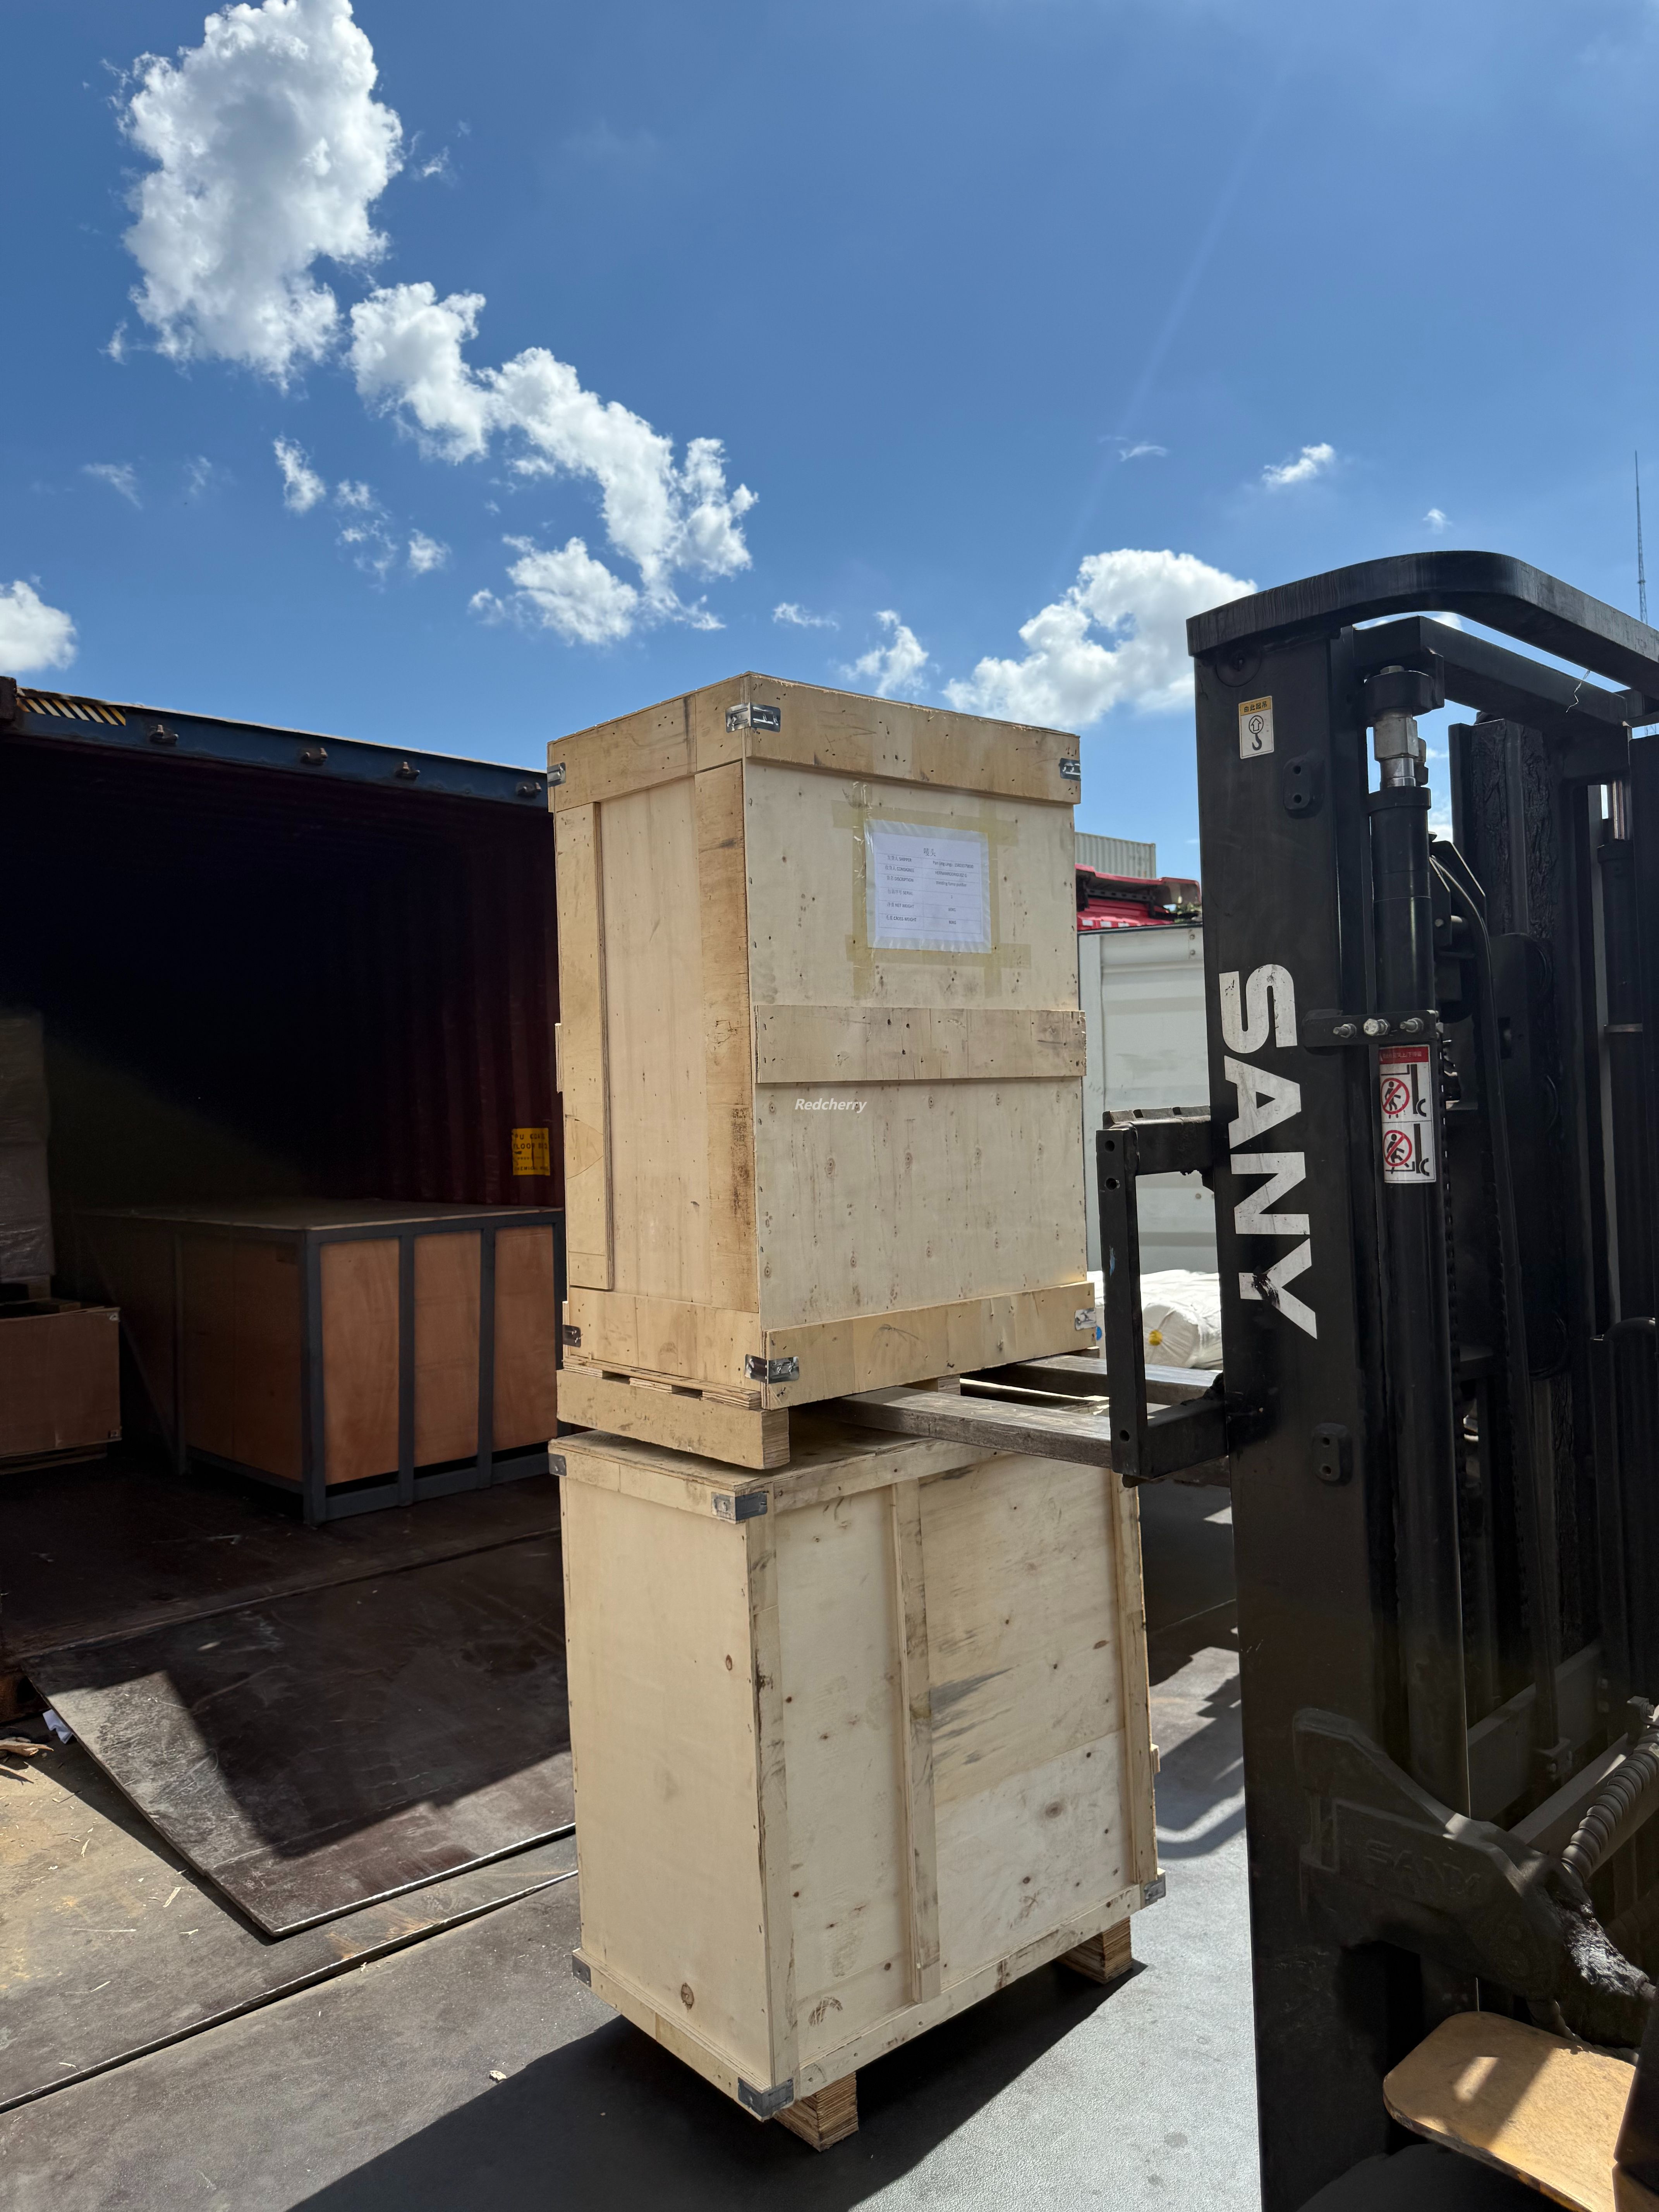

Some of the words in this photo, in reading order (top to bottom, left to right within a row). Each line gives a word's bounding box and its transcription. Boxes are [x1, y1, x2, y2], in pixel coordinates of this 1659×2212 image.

[1244, 701, 1267, 712] 由此起吊
[1219, 963, 1317, 1339] SANY
